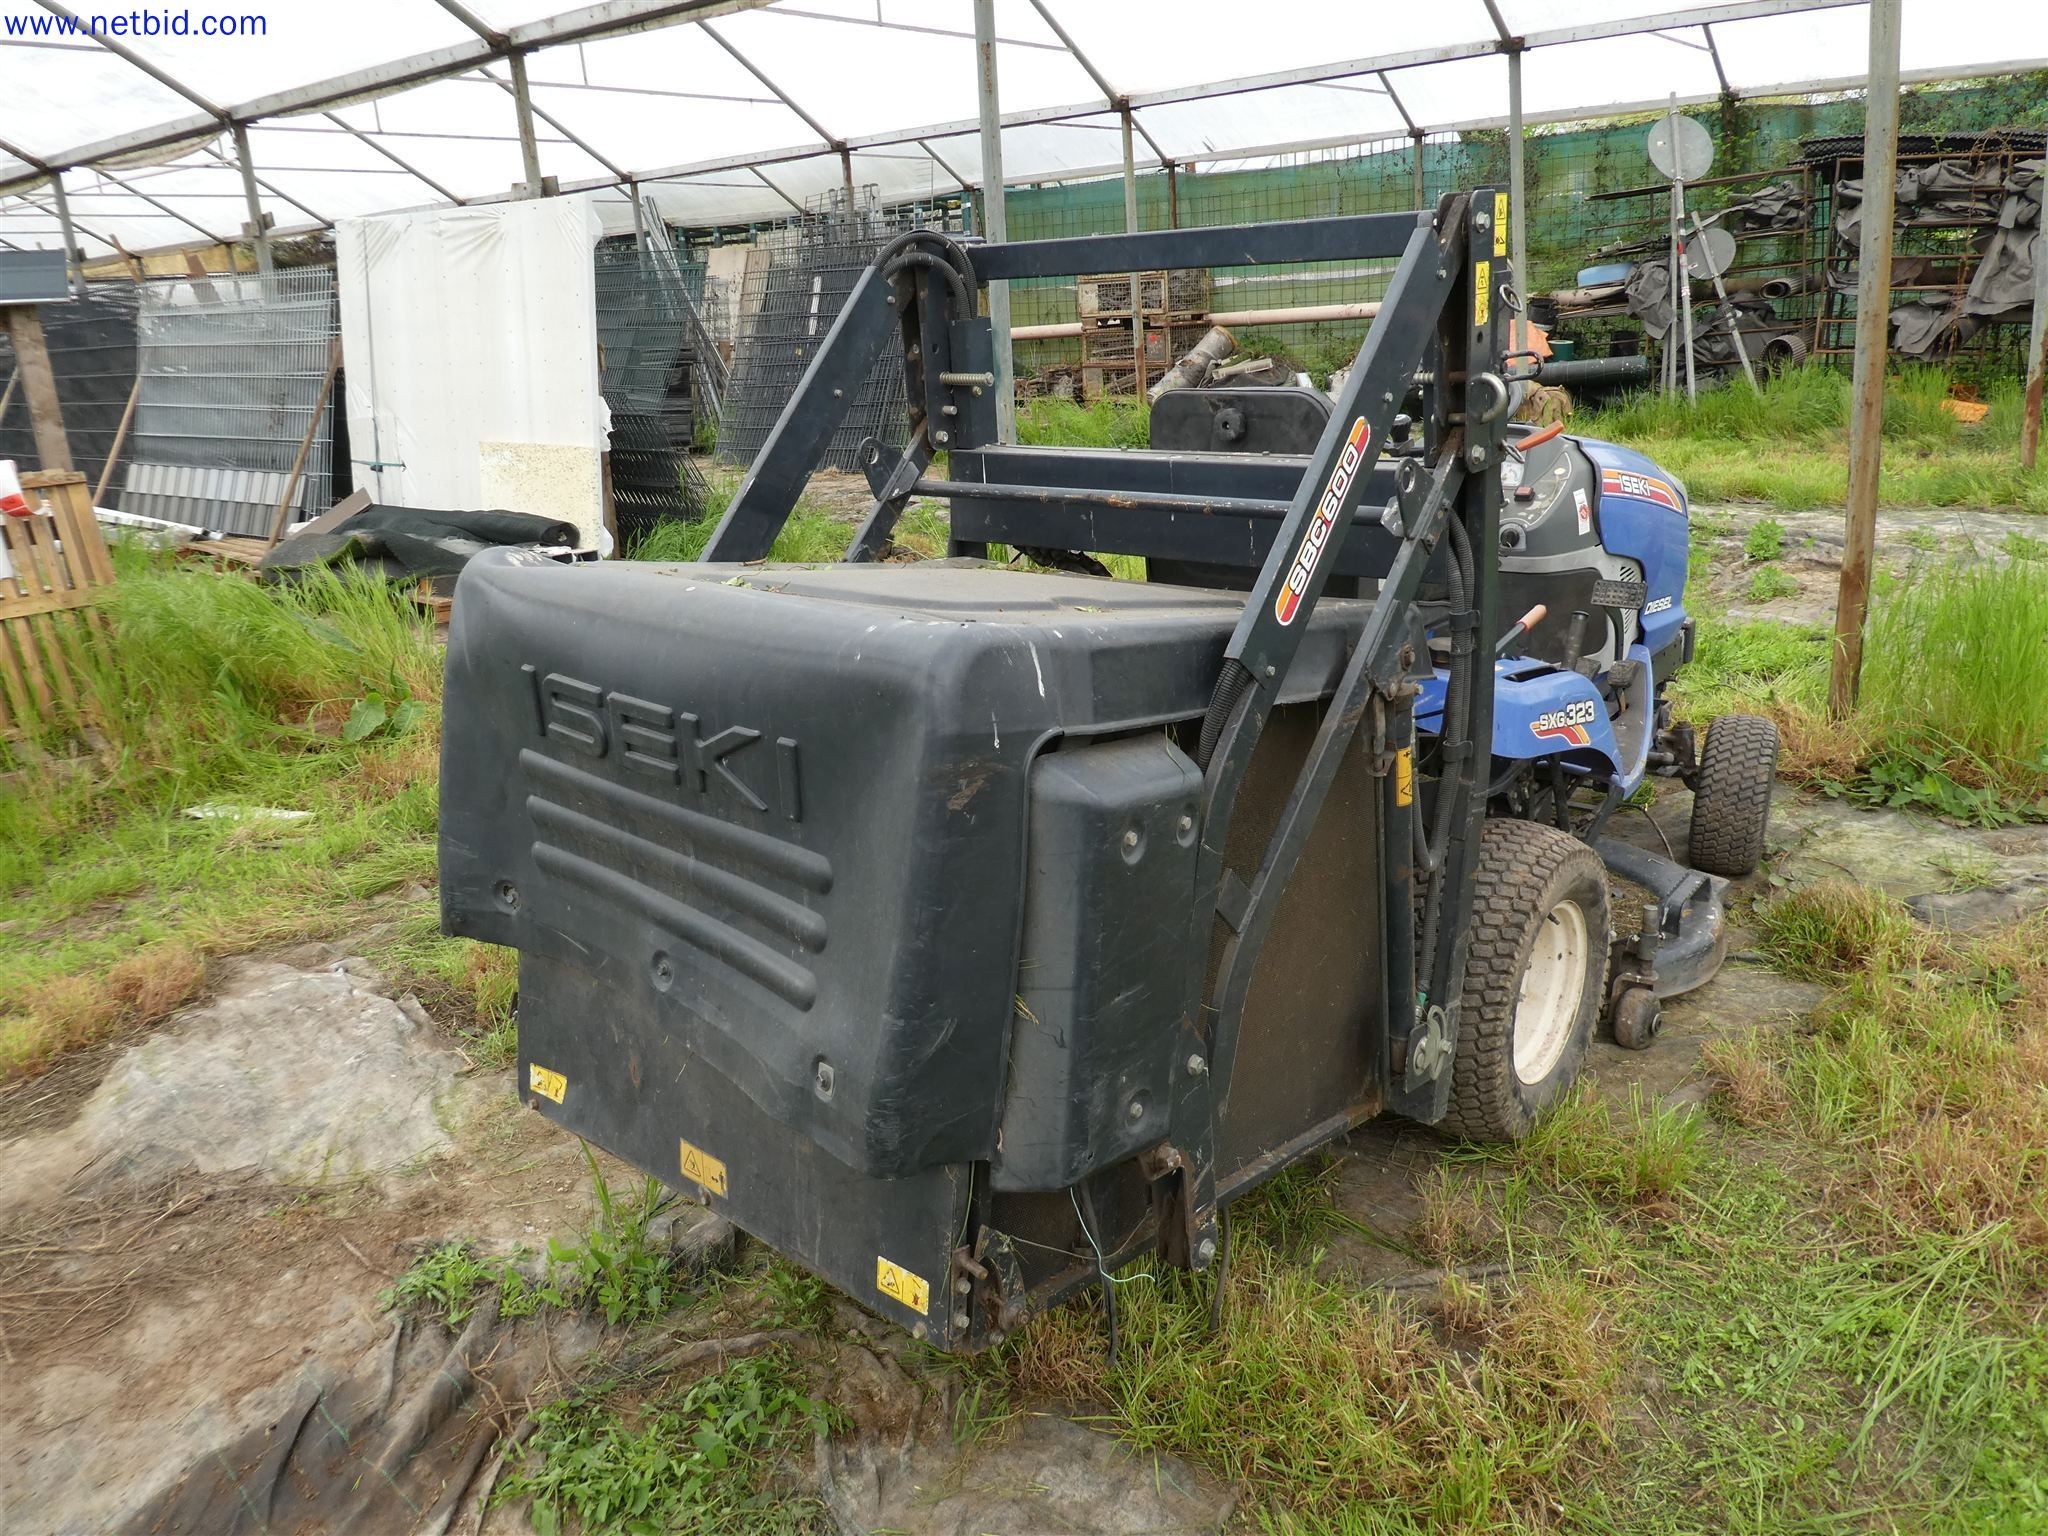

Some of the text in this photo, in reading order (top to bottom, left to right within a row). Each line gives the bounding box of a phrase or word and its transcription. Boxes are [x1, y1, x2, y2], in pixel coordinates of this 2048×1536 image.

[1618, 474, 1651, 497] ISEKI
[1644, 595, 1672, 616] DIESEL
[520, 663, 803, 824] ISEKI
